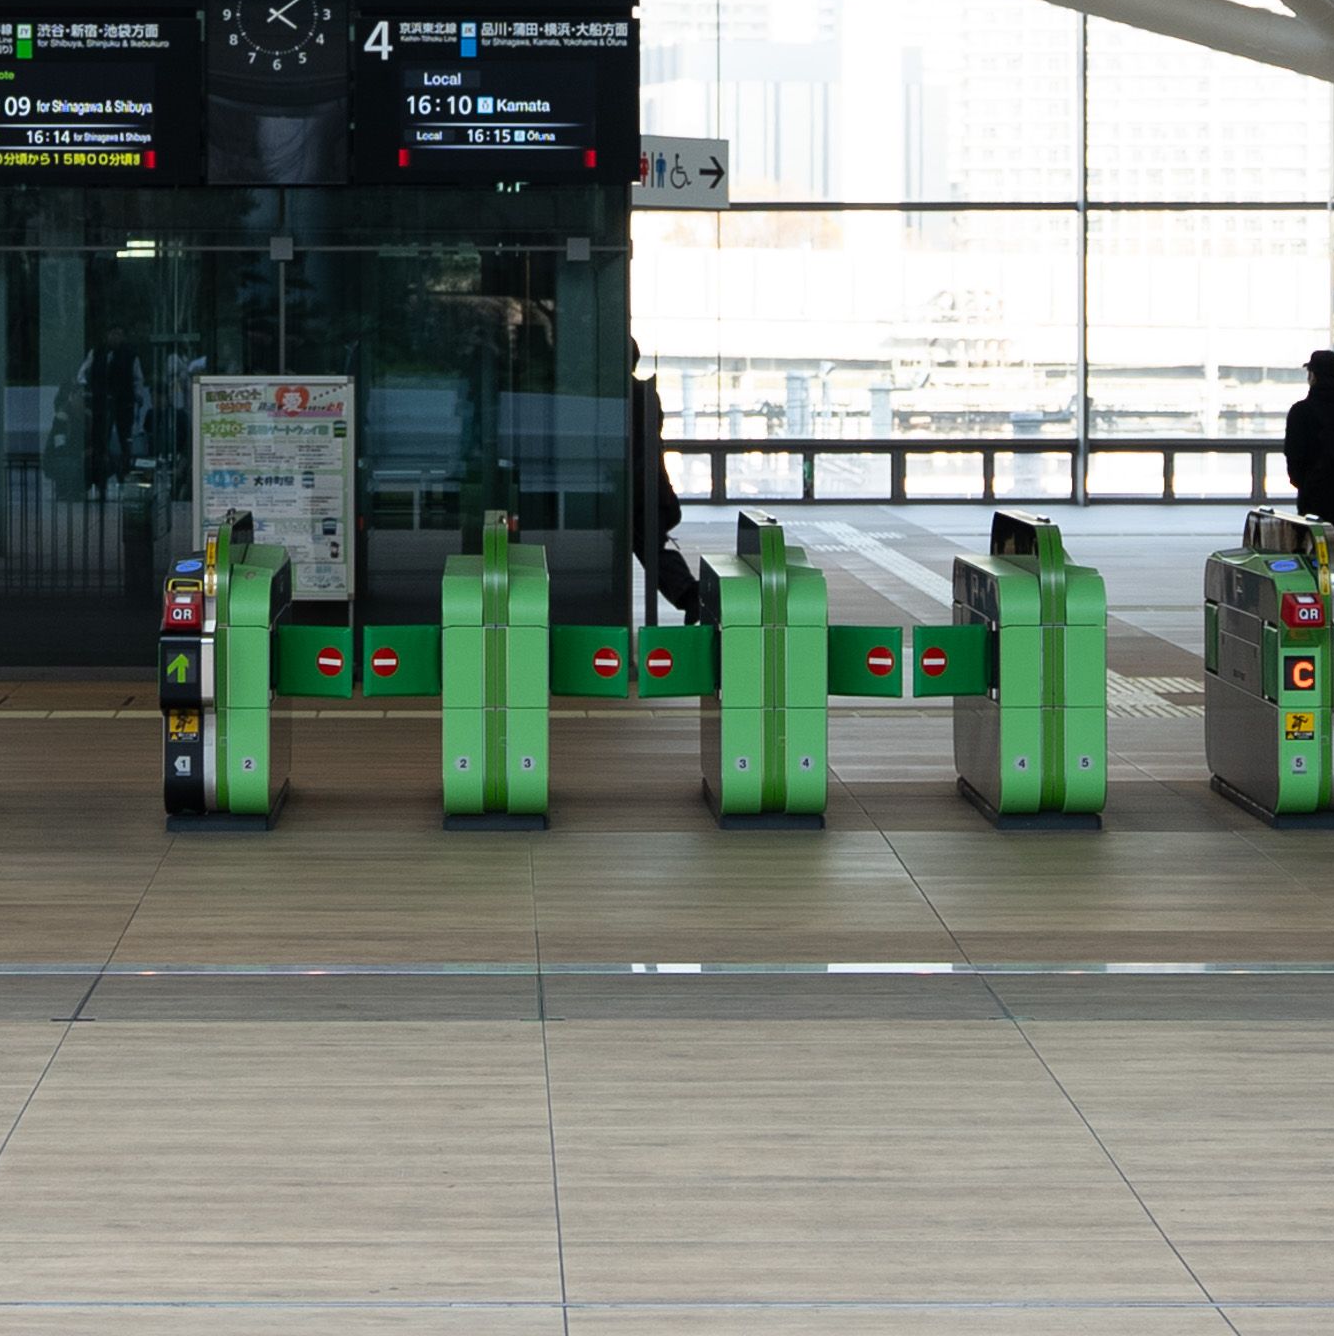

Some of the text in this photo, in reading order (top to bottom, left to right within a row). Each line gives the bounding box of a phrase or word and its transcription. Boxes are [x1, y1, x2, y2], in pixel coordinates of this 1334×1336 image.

[222, 9, 231, 21] 9
[323, 9, 331, 20] 3
[399, 22, 458, 35] 京浜東北線
[37, 39, 49, 48] for
[86, 39, 120, 49] Shinjuku
[229, 34, 238, 46] 8
[316, 33, 325, 45] 4
[363, 20, 394, 61] 4
[481, 38, 491, 46] for
[248, 52, 256, 64] 7
[298, 52, 307, 64] 5
[273, 59, 282, 71] 6
[424, 72, 462, 86] Local
[36, 100, 51, 113] for
[51, 100, 103, 115] Shinagawa
[105, 100, 113, 113] &
[114, 100, 153, 116] Shibuya
[407, 95, 551, 115] 16:10 Kamata
[26, 129, 70, 144] 16:14
[73, 132, 83, 142] for
[416, 131, 443, 141] Local
[467, 129, 511, 143] 16:15
[172, 607, 193, 620] QR
[1298, 607, 1319, 620] QR
[1292, 661, 1314, 689] C
[180, 759, 186, 768] 1
[244, 759, 252, 769] 2
[459, 758, 467, 768] 2
[523, 758, 531, 768] 3
[739, 758, 747, 769] 3
[802, 758, 809, 767] 4
[1018, 759, 1026, 768] 4
[1081, 758, 1089, 767] 5
[1295, 757, 1303, 767] 5
